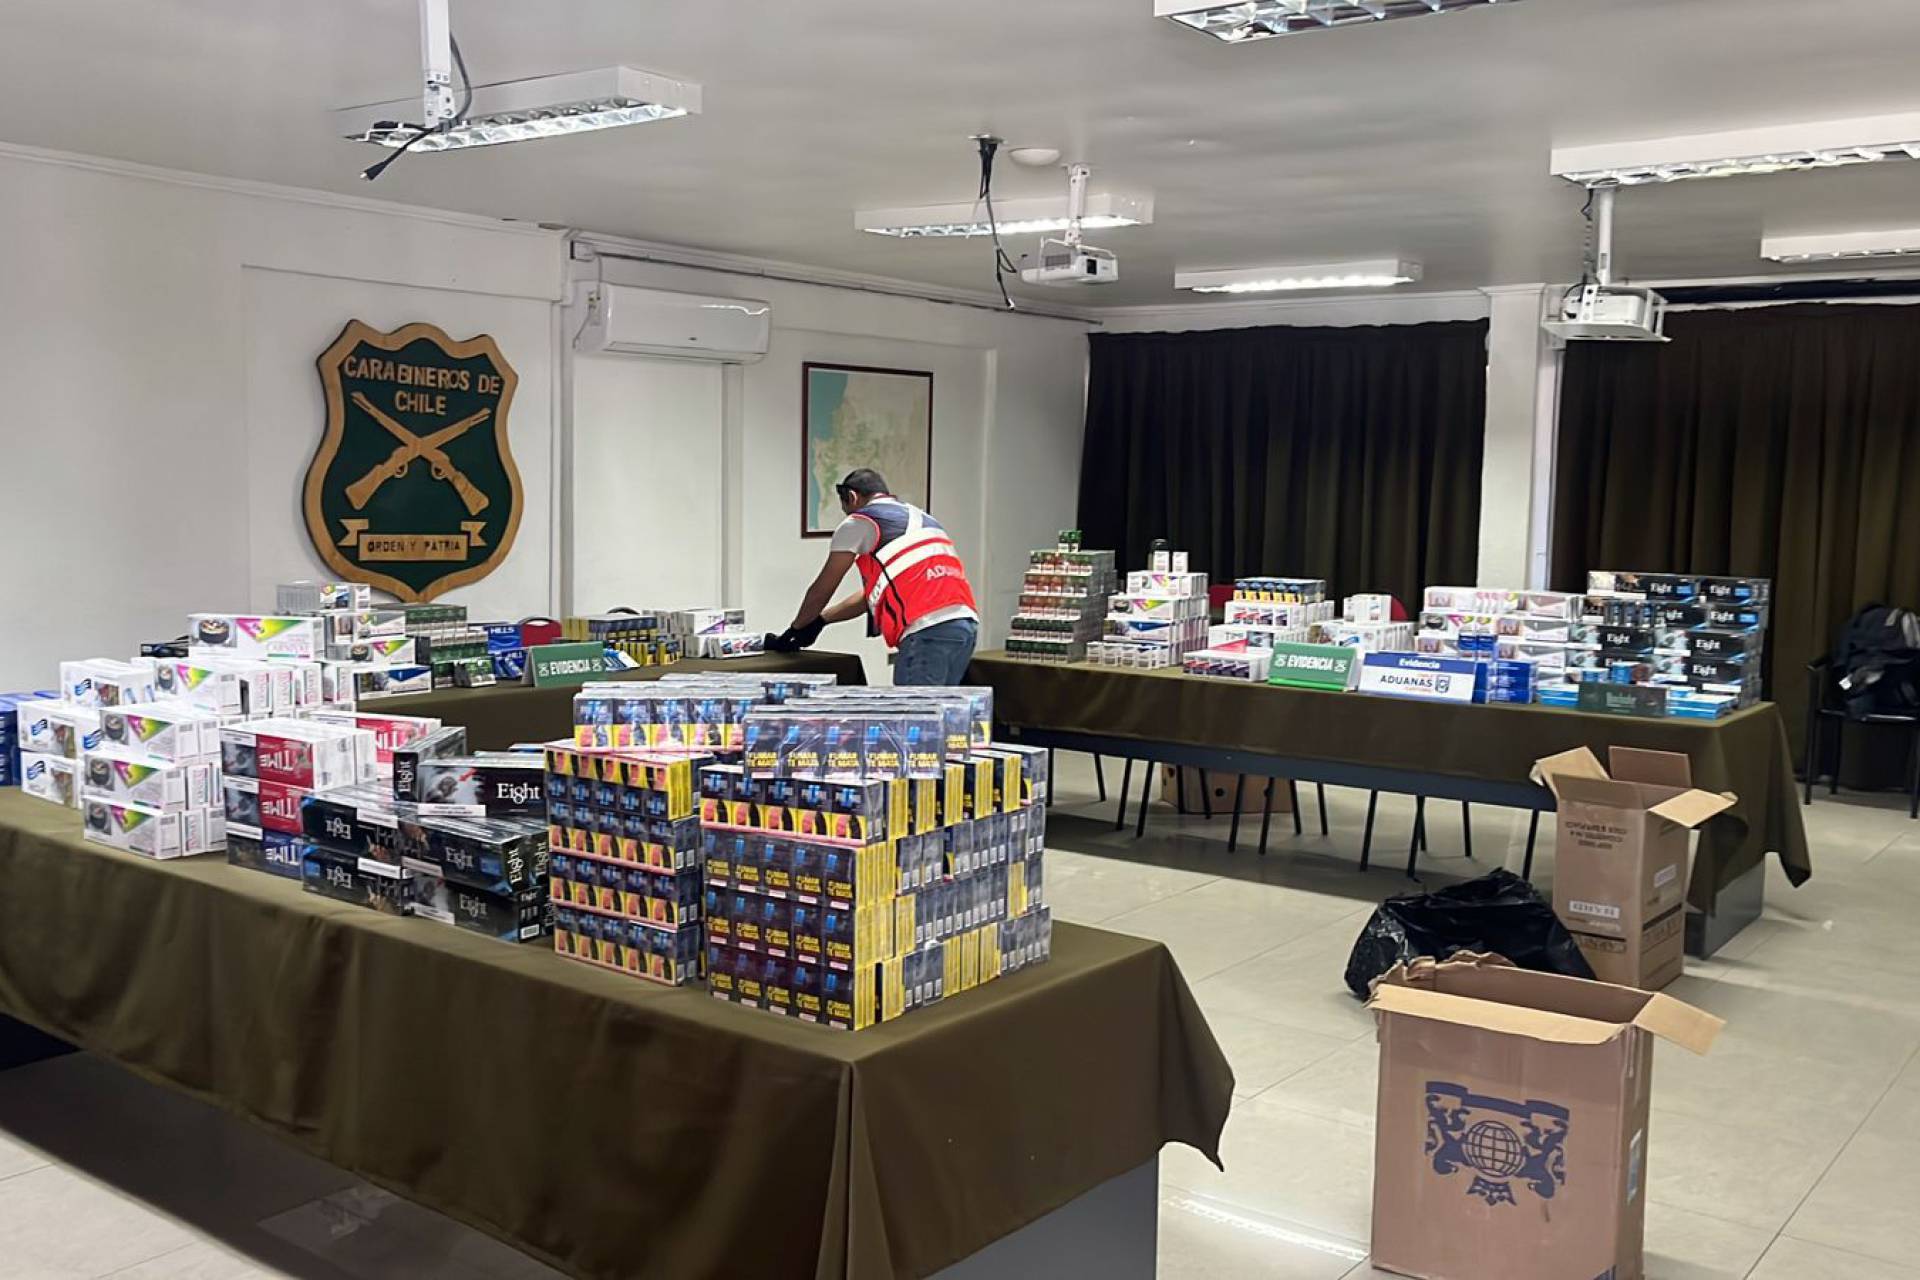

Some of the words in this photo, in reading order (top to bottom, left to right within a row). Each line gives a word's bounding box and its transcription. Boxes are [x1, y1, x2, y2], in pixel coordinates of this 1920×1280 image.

[345, 356, 471, 391] CARABINEROS
[478, 374, 500, 395] DE
[395, 391, 447, 416] CHILE
[368, 541, 405, 552] ORDEN
[409, 541, 416, 552] Y
[425, 540, 460, 551] PATRIA
[549, 659, 590, 675] EVIDENCIA
[1287, 654, 1333, 672] EVIDENCIA
[1399, 657, 1440, 669] Evidencia
[1380, 674, 1433, 688] ADUANAS
[260, 750, 294, 772] TIME
[496, 782, 541, 804] Eight
[262, 798, 297, 819] TIME
[265, 844, 299, 866] TIME
[507, 848, 524, 884] Eight
[459, 893, 488, 917] Eight
